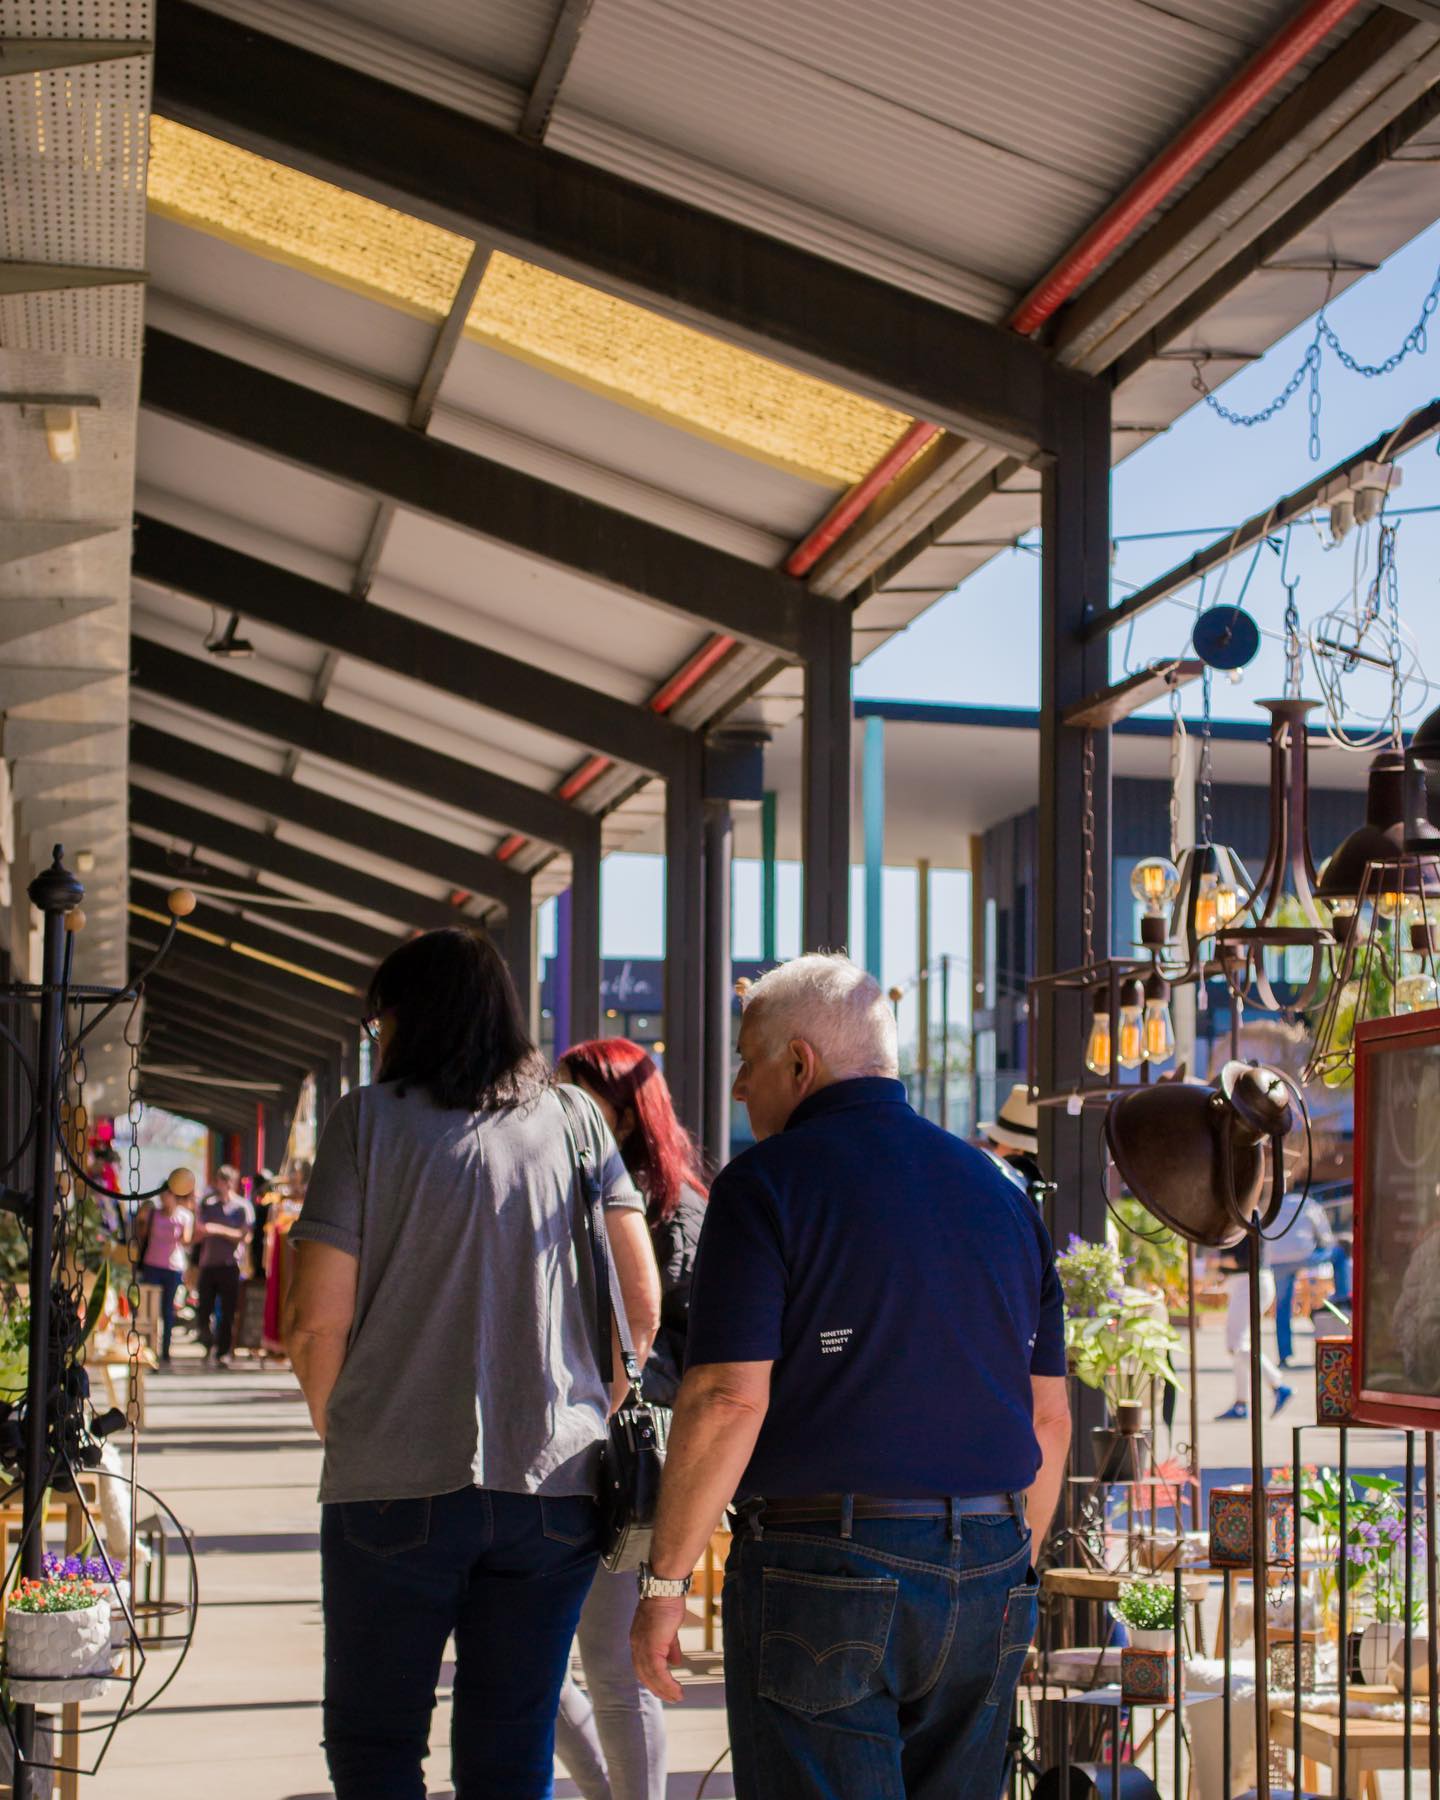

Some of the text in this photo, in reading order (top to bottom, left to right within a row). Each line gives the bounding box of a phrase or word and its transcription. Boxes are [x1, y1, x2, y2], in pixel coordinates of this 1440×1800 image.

[820, 1328, 853, 1338] NINETEEN
[821, 1337, 849, 1346] TWENTY
[821, 1346, 843, 1354] SEVEN
